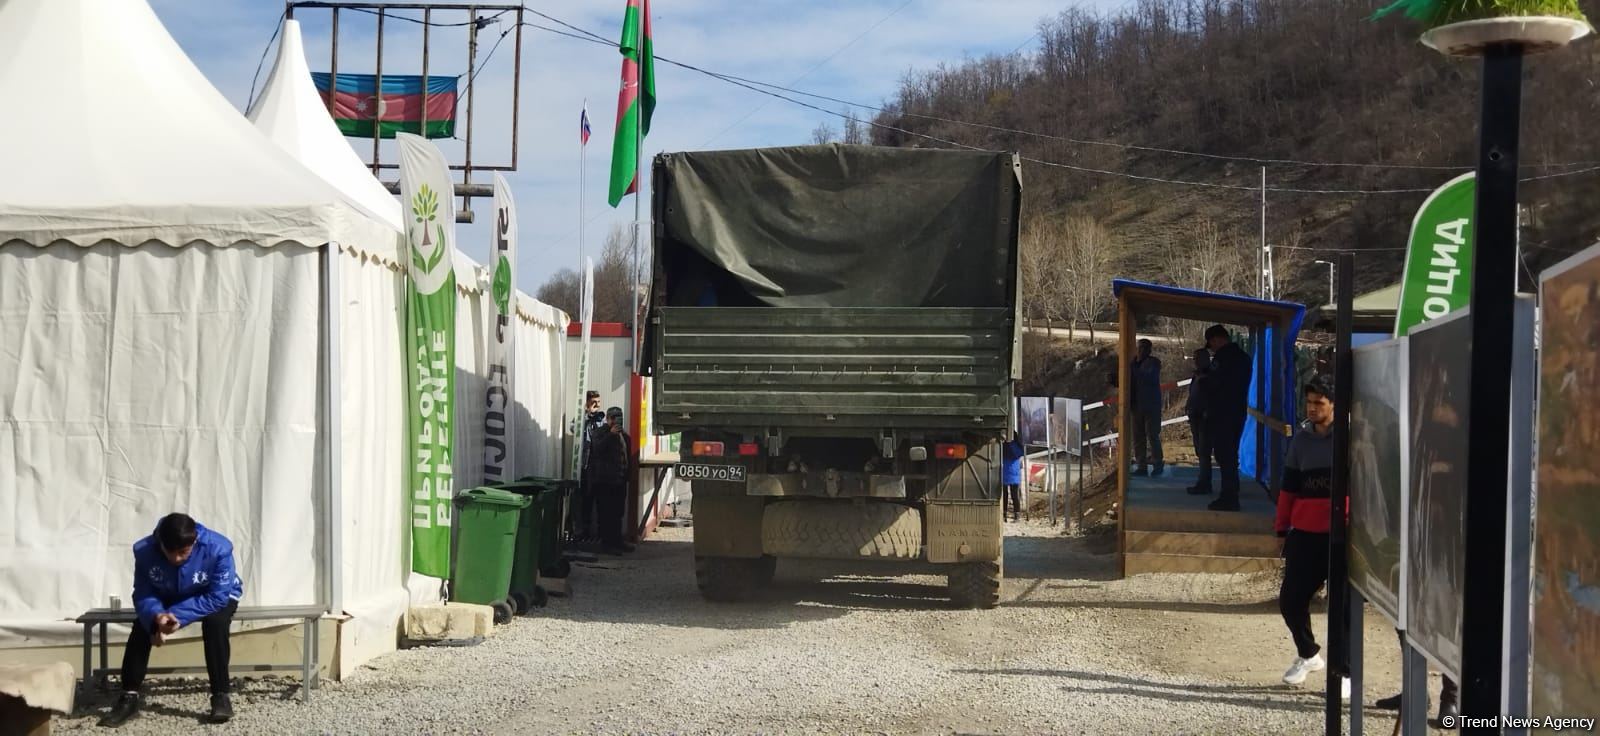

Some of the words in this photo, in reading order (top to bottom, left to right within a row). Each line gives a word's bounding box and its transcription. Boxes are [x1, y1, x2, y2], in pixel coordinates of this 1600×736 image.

[1421, 218, 1469, 323] ОЦИД
[679, 465, 710, 478] 0850
[729, 467, 742, 477] 94
